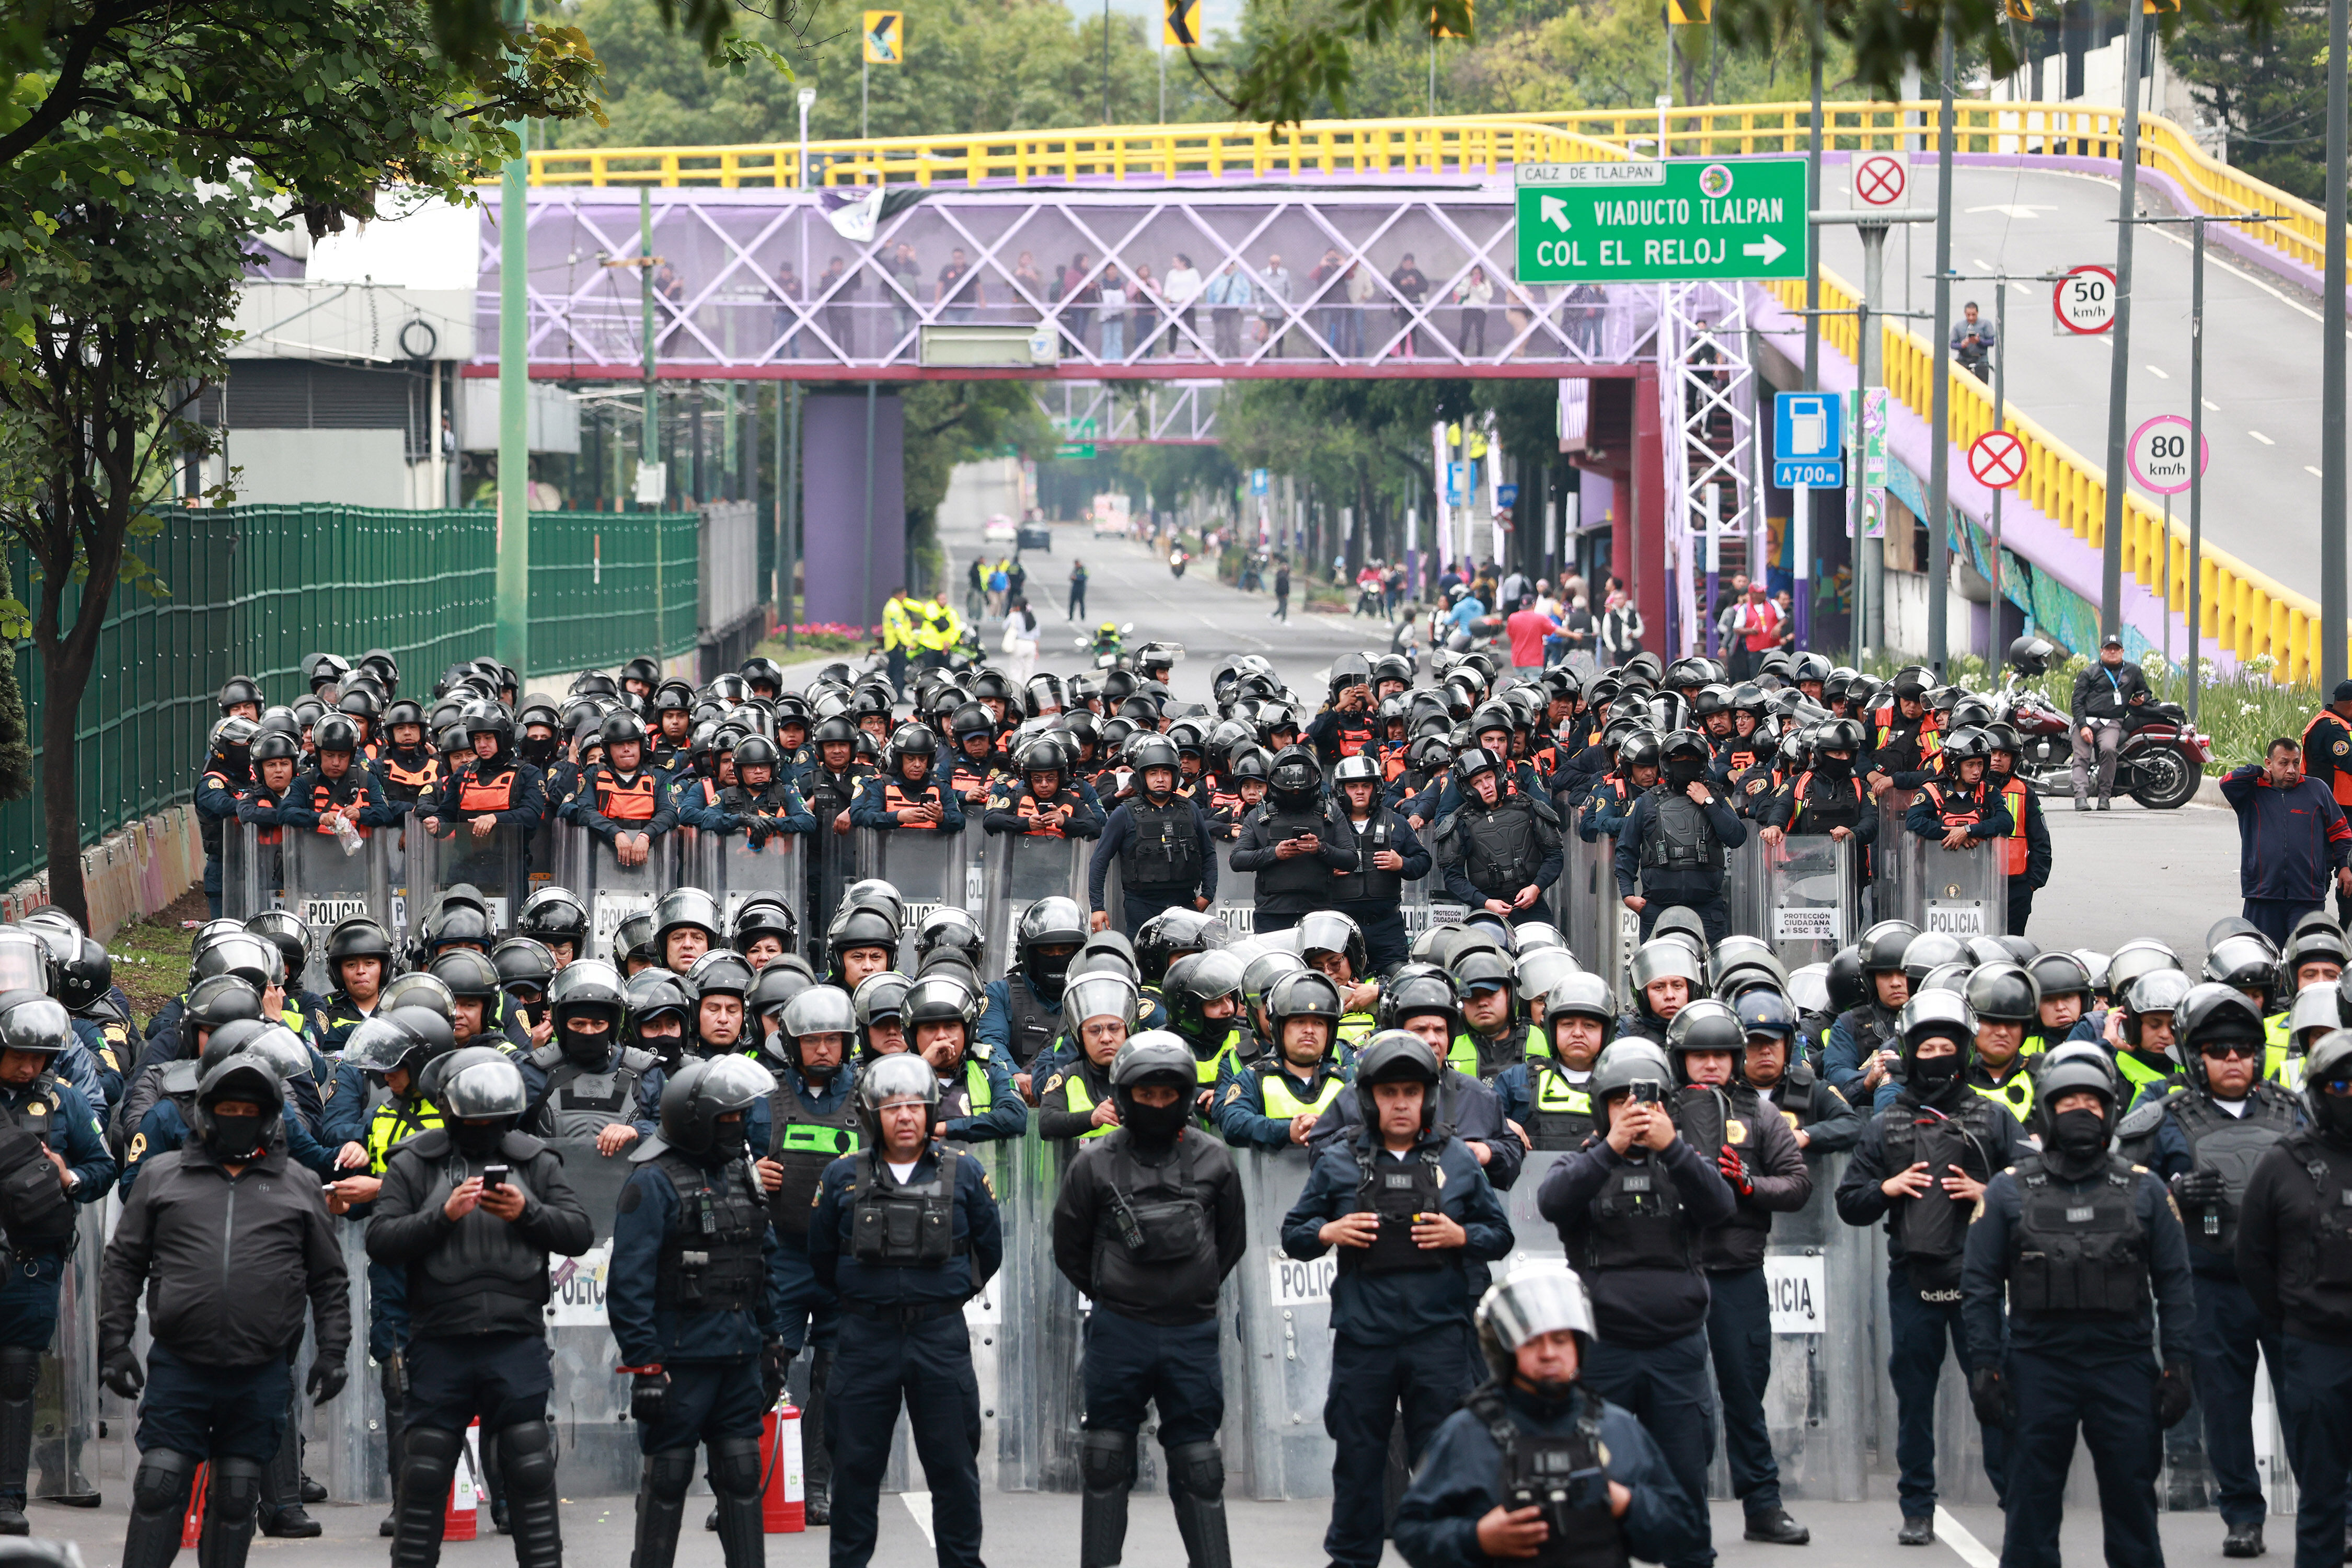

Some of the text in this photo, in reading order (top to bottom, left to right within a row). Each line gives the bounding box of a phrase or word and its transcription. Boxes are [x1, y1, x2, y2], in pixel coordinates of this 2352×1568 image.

[1525, 166, 1653, 180] CALZ DE TLALPAN
[1594, 197, 1784, 226] VIADUCTO TLALPAN
[1536, 238, 1726, 267] COL EL RELOJ
[2075, 282, 2104, 302] 50
[2073, 305, 2105, 317] km/h
[2151, 436, 2184, 458] 80
[2150, 462, 2185, 475] km/h
[1931, 913, 1979, 933] POLICIA
[550, 1271, 605, 1306] POLIC
[1280, 1261, 1334, 1298] POLIC
[1920, 1288, 1963, 1302] adid
